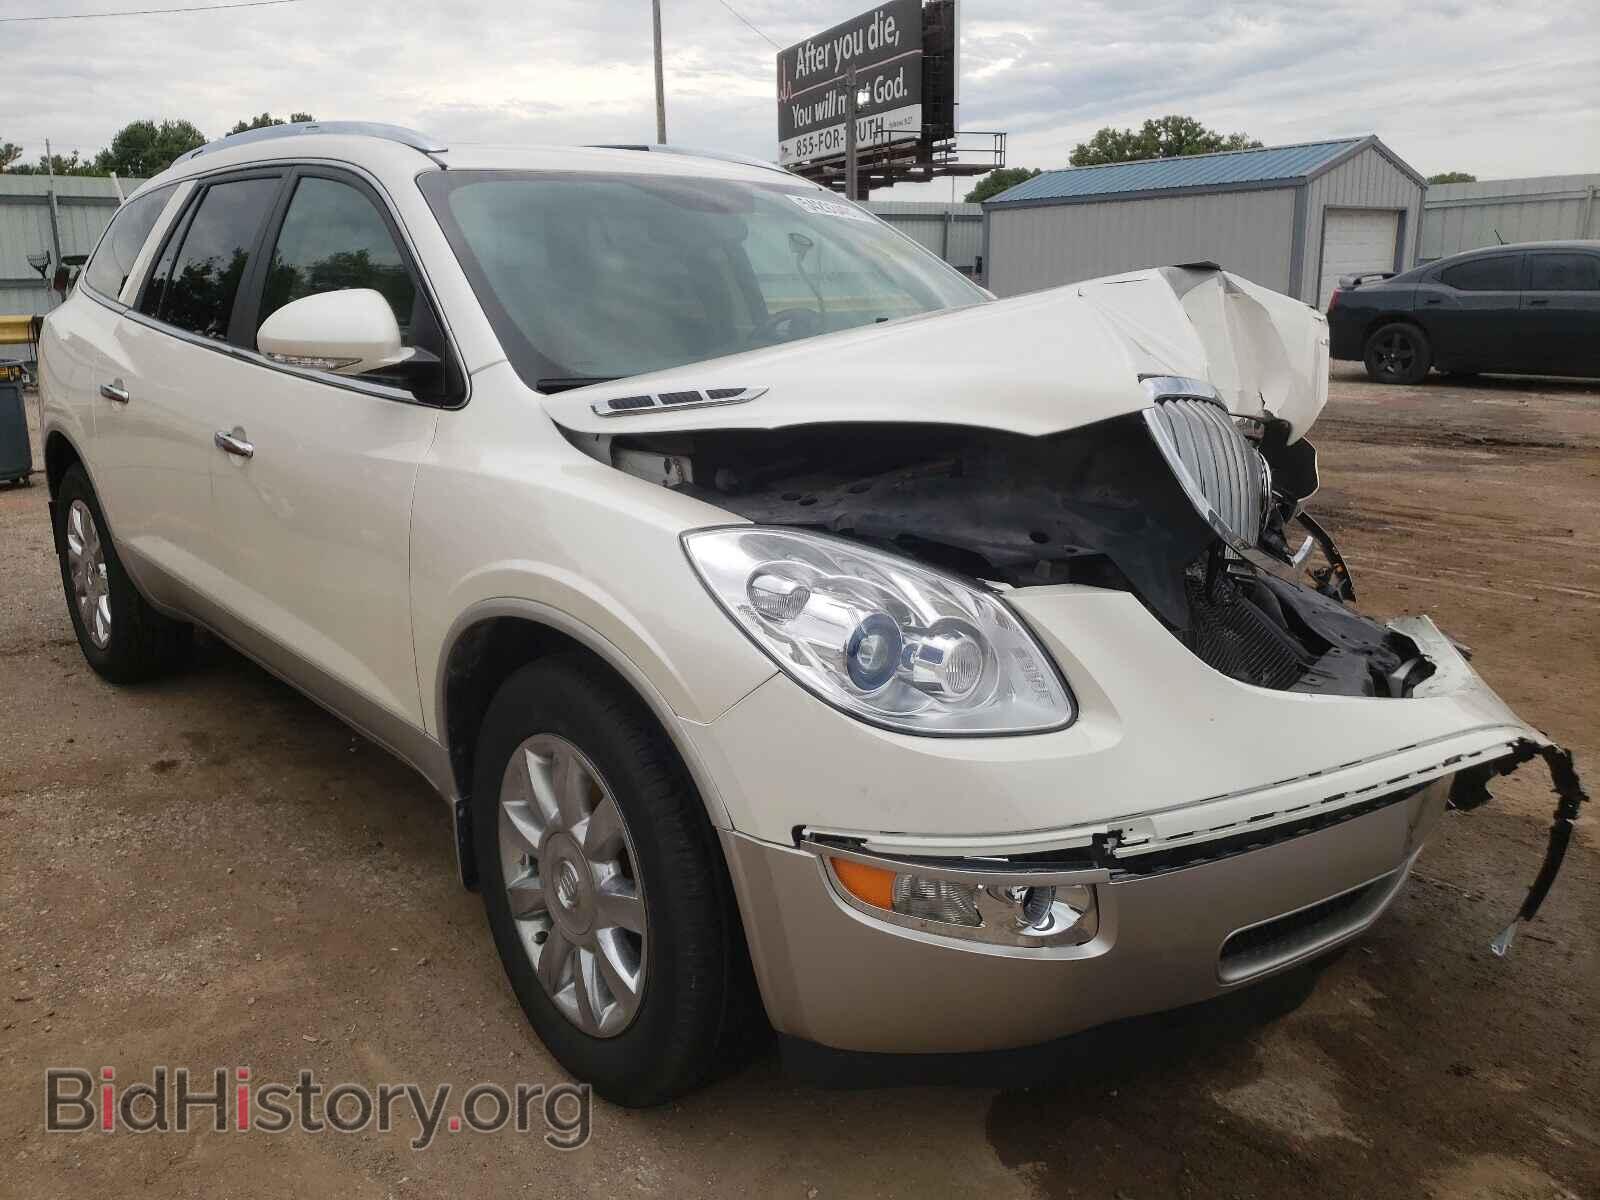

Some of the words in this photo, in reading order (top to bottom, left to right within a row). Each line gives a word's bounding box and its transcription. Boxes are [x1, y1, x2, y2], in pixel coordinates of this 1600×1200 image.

[795, 39, 830, 79] After
[834, 28, 863, 72] you
[868, 10, 900, 49] die,
[792, 104, 812, 129] You
[815, 91, 836, 121] will
[874, 66, 908, 104] God.
